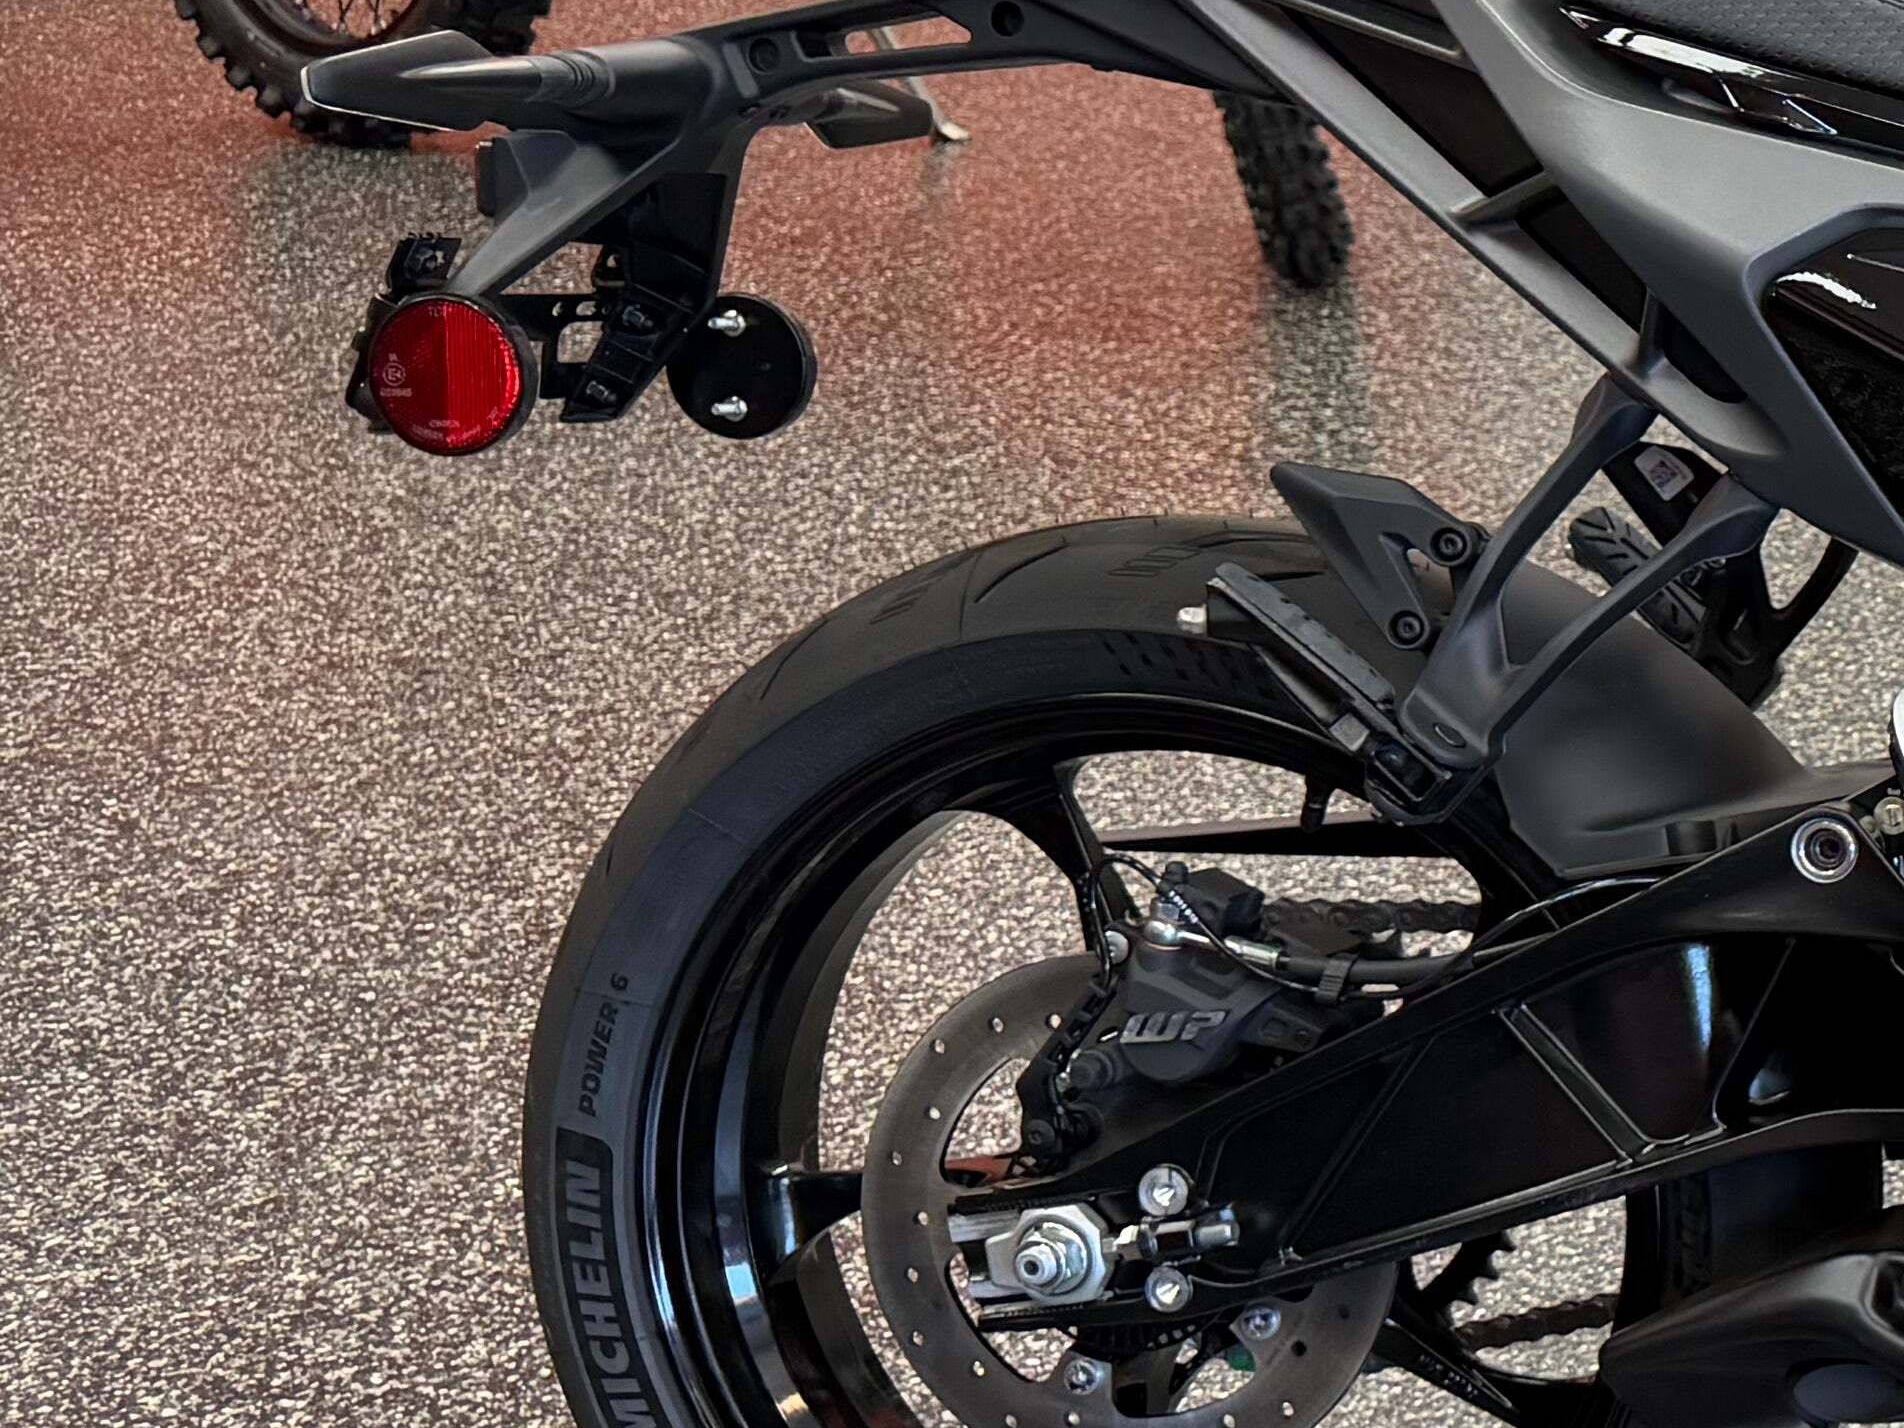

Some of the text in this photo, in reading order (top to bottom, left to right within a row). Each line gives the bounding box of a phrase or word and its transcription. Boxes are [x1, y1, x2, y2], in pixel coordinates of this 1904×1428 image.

[577, 972, 630, 1117] POWER 6
[1119, 1010, 1227, 1044] WP
